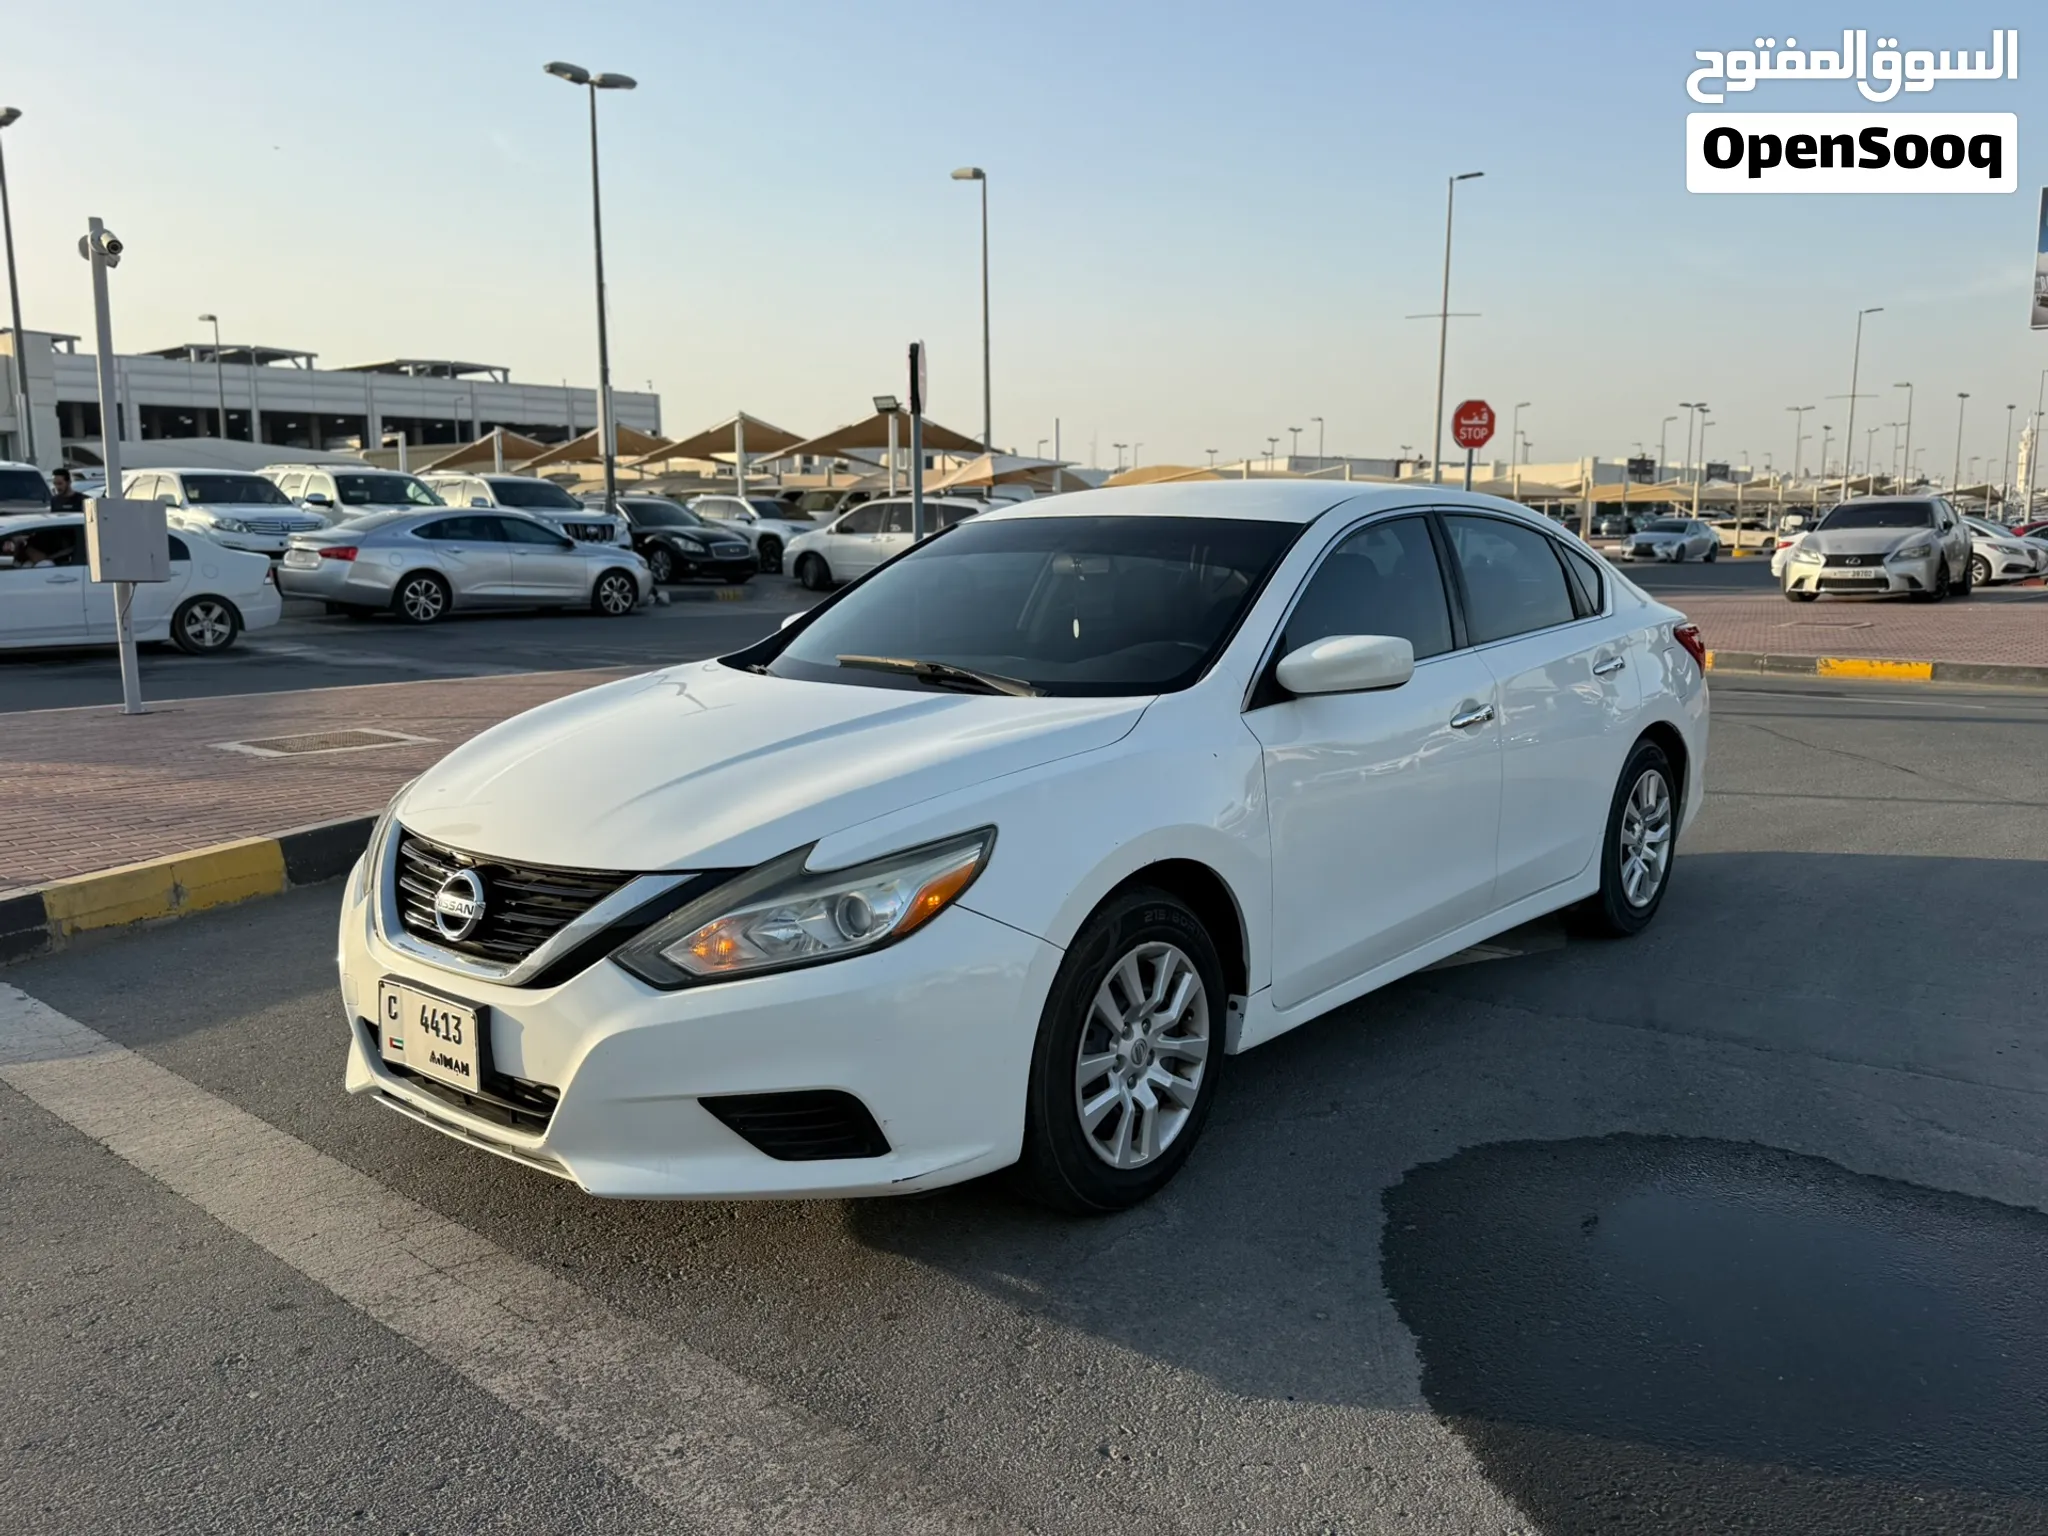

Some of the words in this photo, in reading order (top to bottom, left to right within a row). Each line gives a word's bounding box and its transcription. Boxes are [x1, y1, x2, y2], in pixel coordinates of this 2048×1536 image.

[1461, 407, 1489, 425] قف
[1459, 427, 1489, 440] STOP
[438, 899, 475, 916] NISSAN
[388, 995, 398, 1020] C
[420, 1004, 462, 1045] 4413
[429, 1050, 470, 1077] AJMAN
